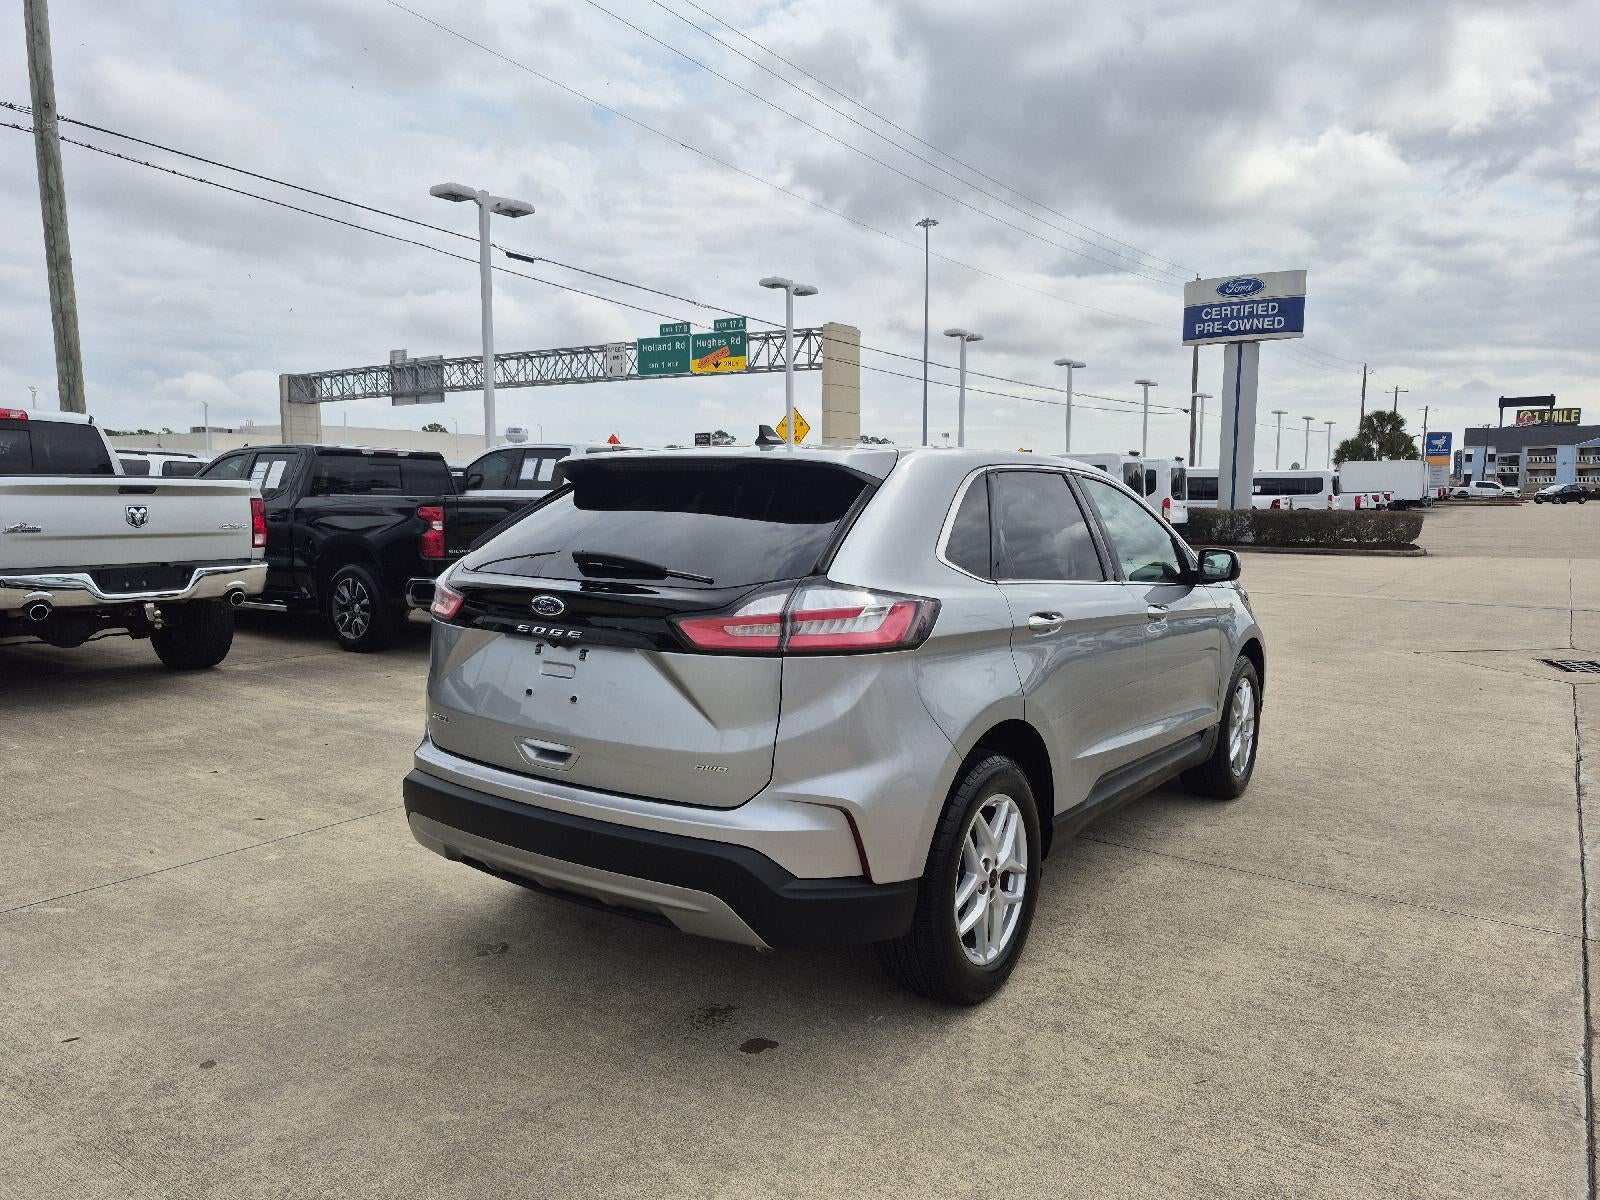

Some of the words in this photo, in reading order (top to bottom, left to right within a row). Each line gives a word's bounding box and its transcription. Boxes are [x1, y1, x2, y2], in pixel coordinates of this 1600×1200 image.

[1201, 302, 1279, 319] CERTIFIED
[1195, 316, 1285, 335] PRE-OWNED
[642, 342, 672, 352] Holland
[675, 341, 686, 350] Rd
[696, 338, 727, 348] Hughes
[730, 335, 741, 345] Rd
[1544, 409, 1580, 423] MILE
[516, 624, 583, 639] EDGE
